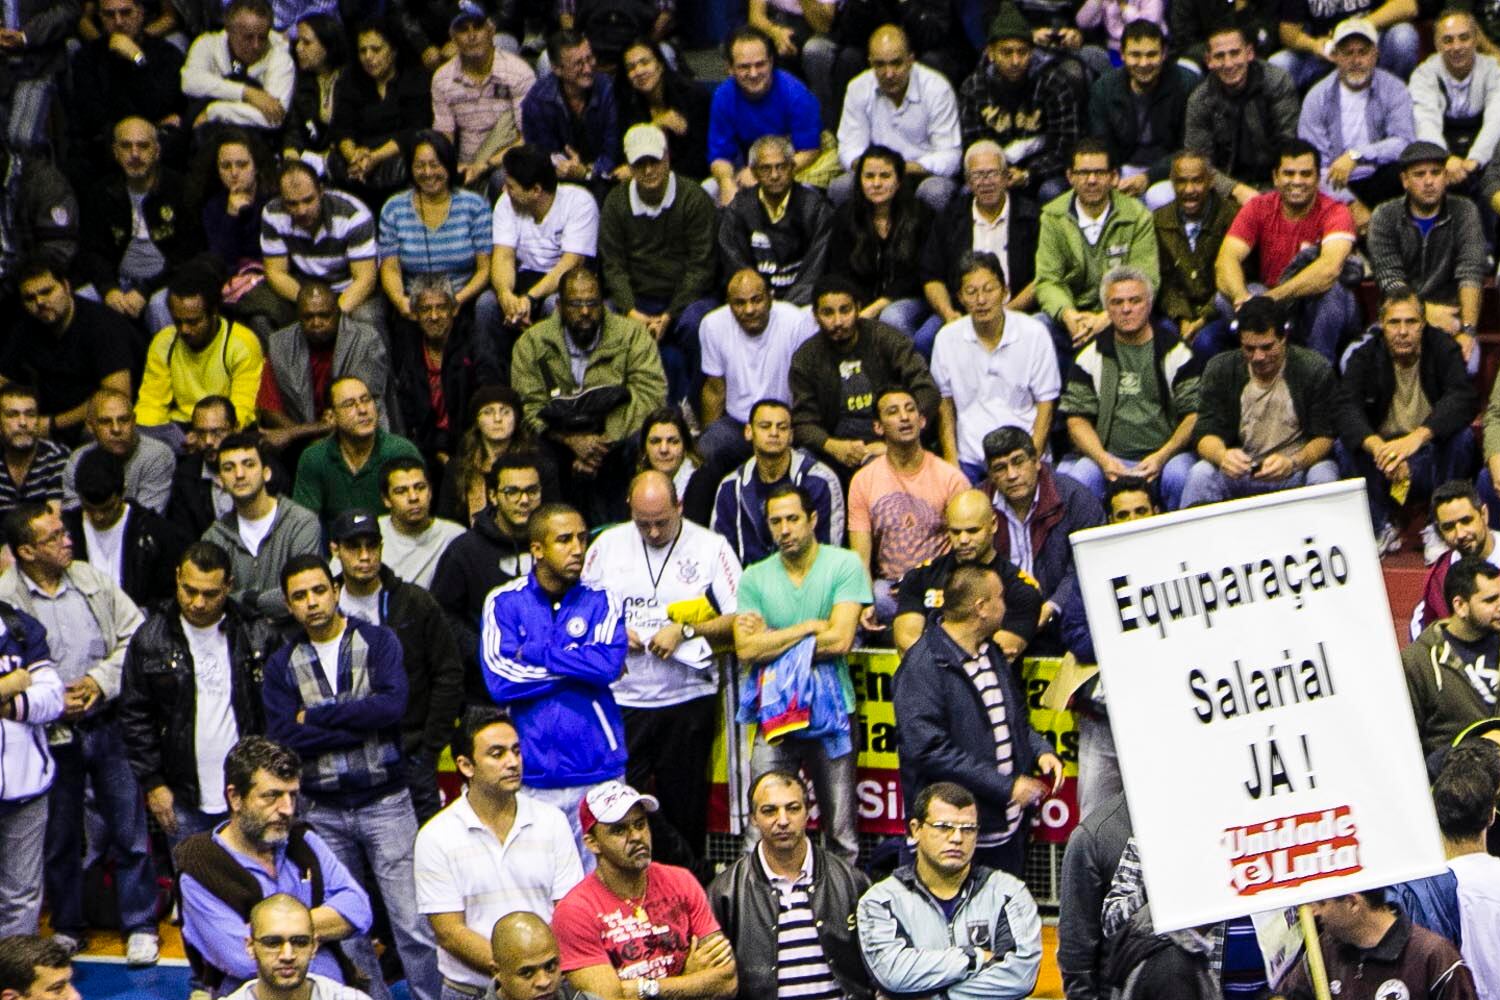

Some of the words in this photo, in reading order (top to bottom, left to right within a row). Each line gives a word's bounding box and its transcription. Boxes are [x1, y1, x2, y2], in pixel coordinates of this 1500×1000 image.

[1108, 536, 1349, 639] Equiparação
[1189, 641, 1336, 724] Salarial
[1244, 724, 1294, 800] JÁ
[1299, 733, 1316, 790] !
[1223, 811, 1357, 858] Unidade
[1273, 841, 1359, 884] Luta
